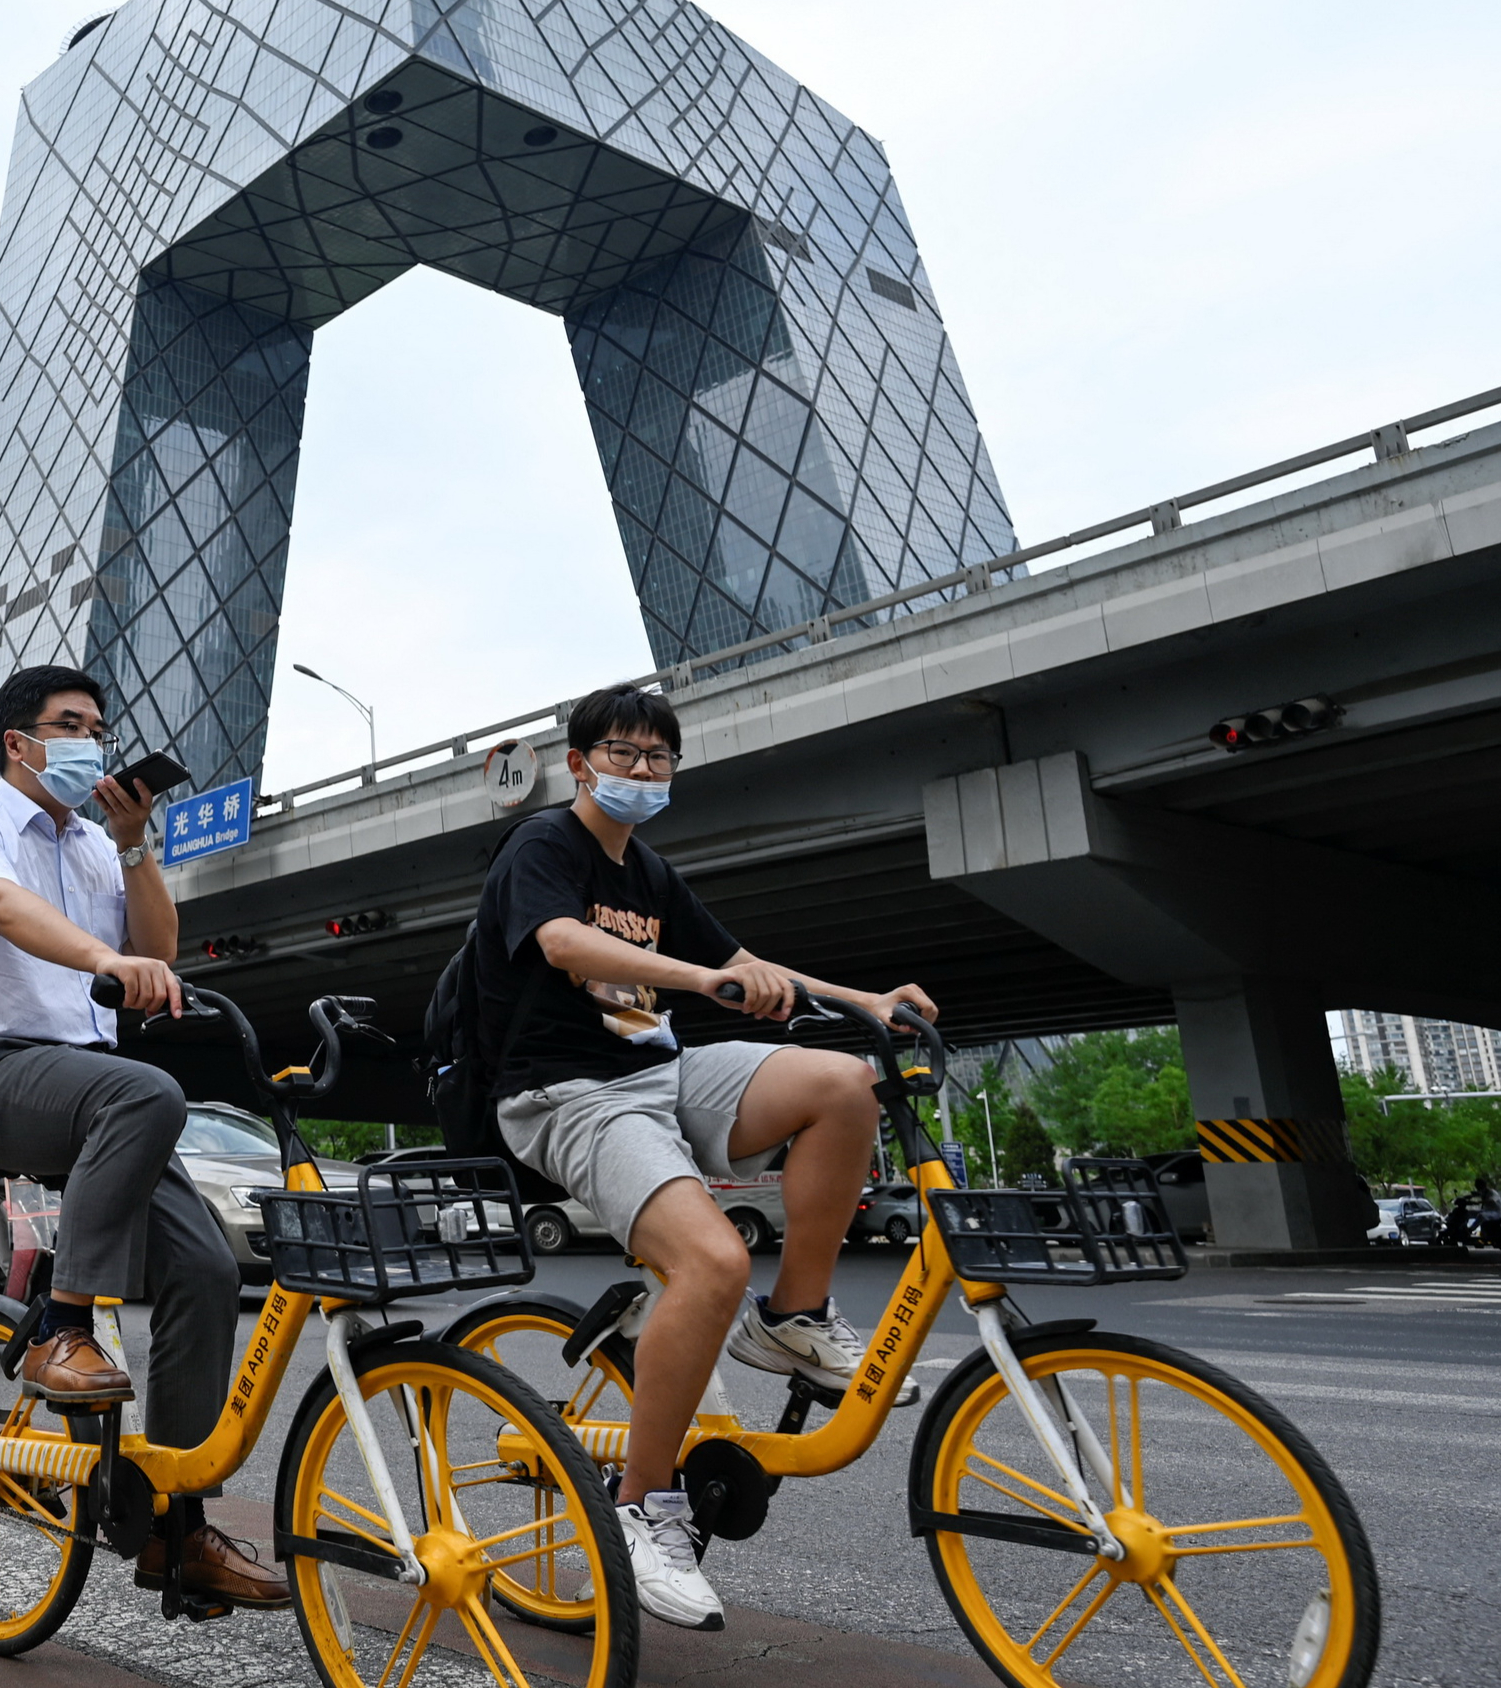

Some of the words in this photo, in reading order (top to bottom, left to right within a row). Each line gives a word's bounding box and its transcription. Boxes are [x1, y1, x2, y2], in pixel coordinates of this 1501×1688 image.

[171, 835, 214, 858] GUANGHUA
[215, 827, 239, 845] Bridge
[173, 792, 241, 838] 光华桥
[230, 1375, 255, 1418] 美团
[247, 1336, 269, 1376] App
[263, 1293, 287, 1336] 扫码
[856, 1362, 886, 1404] 美团
[876, 1326, 902, 1364] App
[893, 1285, 923, 1326] 扫码
